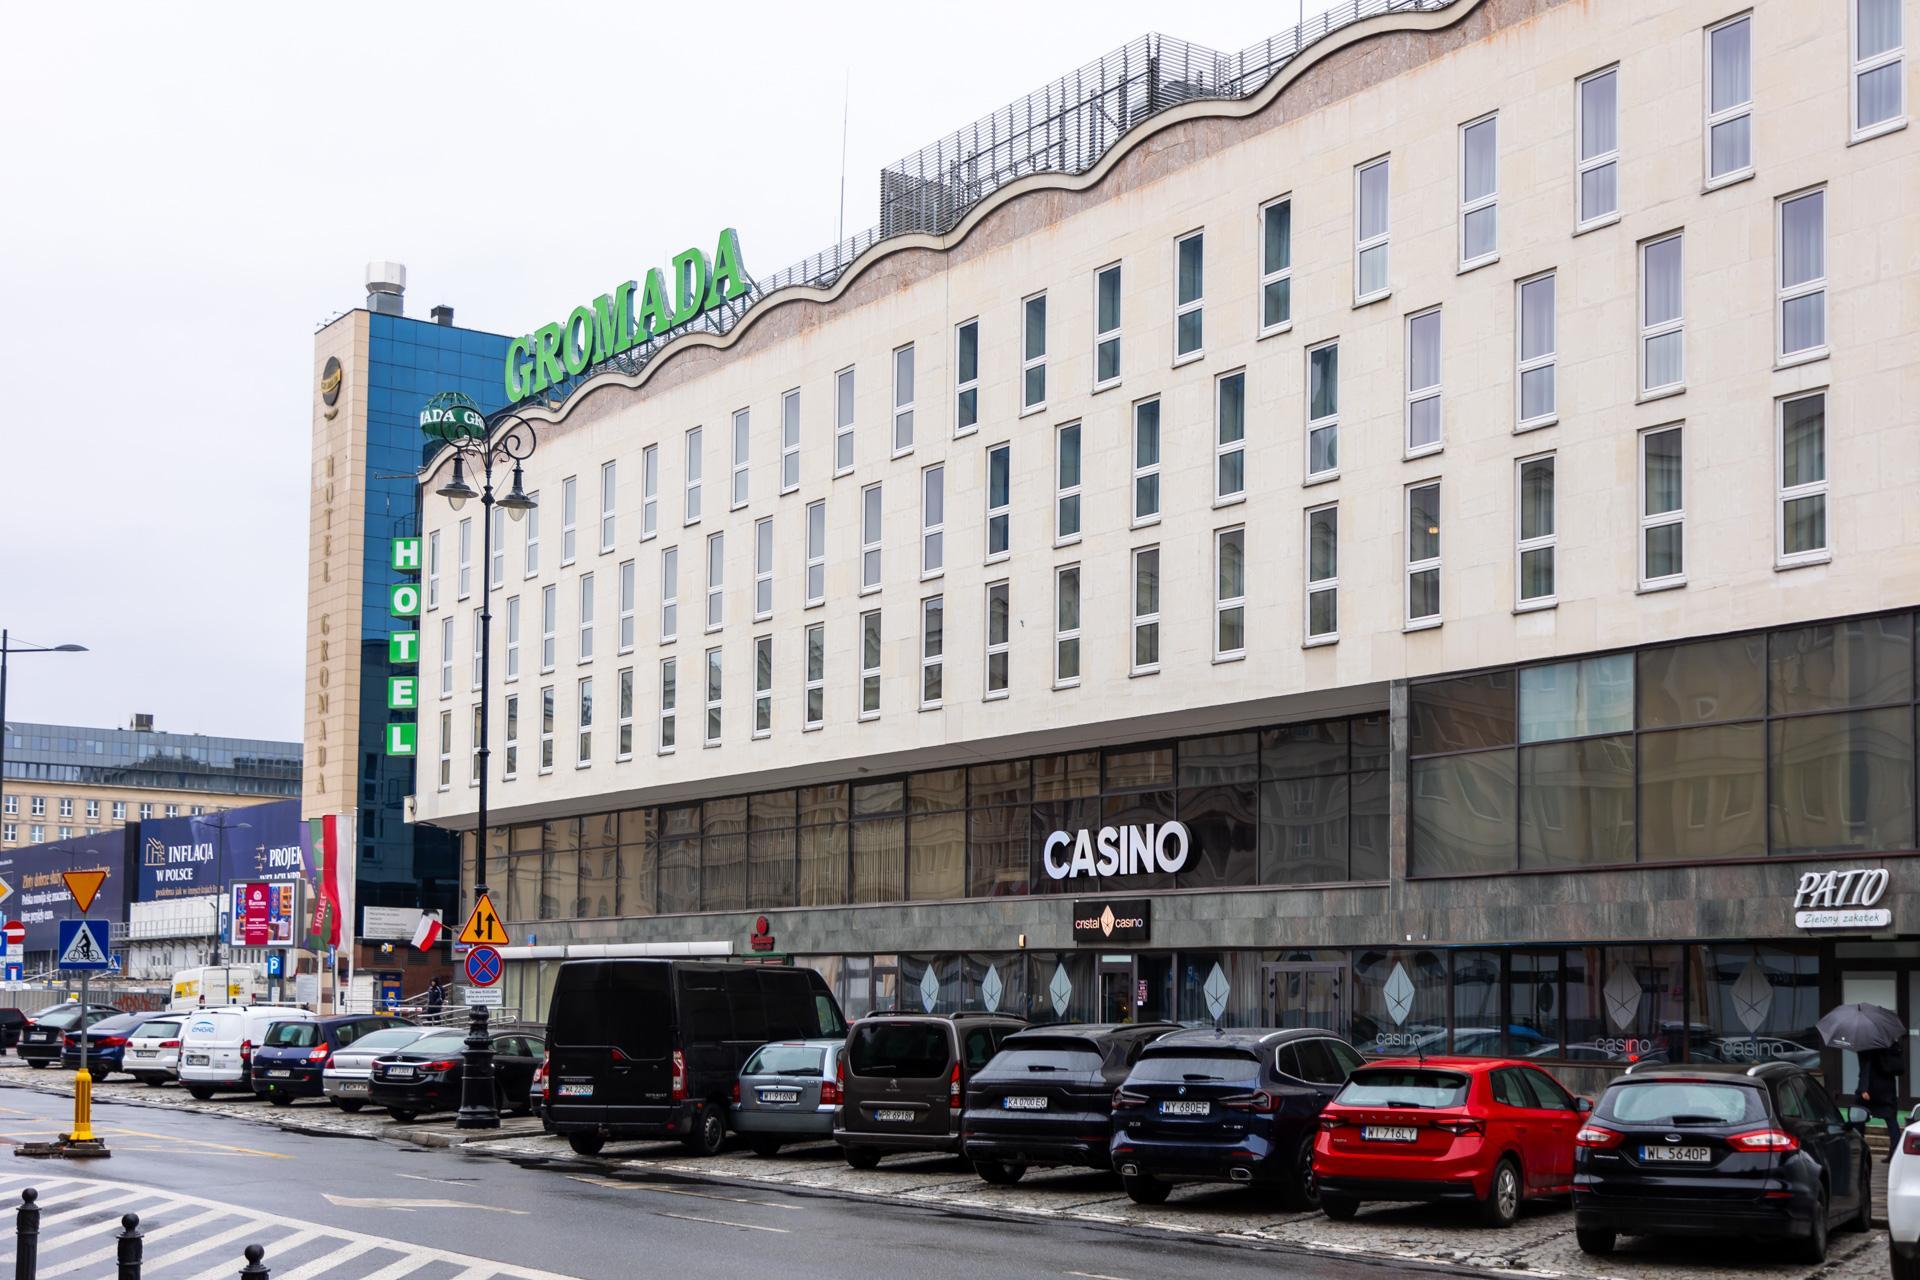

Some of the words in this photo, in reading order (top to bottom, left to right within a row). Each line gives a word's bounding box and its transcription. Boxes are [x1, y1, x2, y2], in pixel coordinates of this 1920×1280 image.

[505, 228, 752, 402] GROMADA
[420, 409, 456, 427] ADA
[392, 541, 419, 752] HOTEL
[168, 843, 214, 864] INFLACJA
[1043, 820, 1189, 880] CASINO
[156, 870, 165, 882] W
[165, 868, 194, 881] POLSCE
[1793, 868, 1890, 908] PATIO
[1114, 918, 1143, 928] casino
[1804, 913, 1839, 925] Zielony
[1375, 1031, 1423, 1045] casino
[1595, 1037, 1651, 1053] casino
[1721, 1040, 1784, 1057] casino
[1164, 1101, 1176, 1112] WY
[1180, 1102, 1209, 1113] 680EF
[1367, 1127, 1379, 1138] WI
[1383, 1128, 1415, 1139] 716LY
[1647, 1147, 1664, 1160] WL
[1668, 1147, 1709, 1160] 5640P
